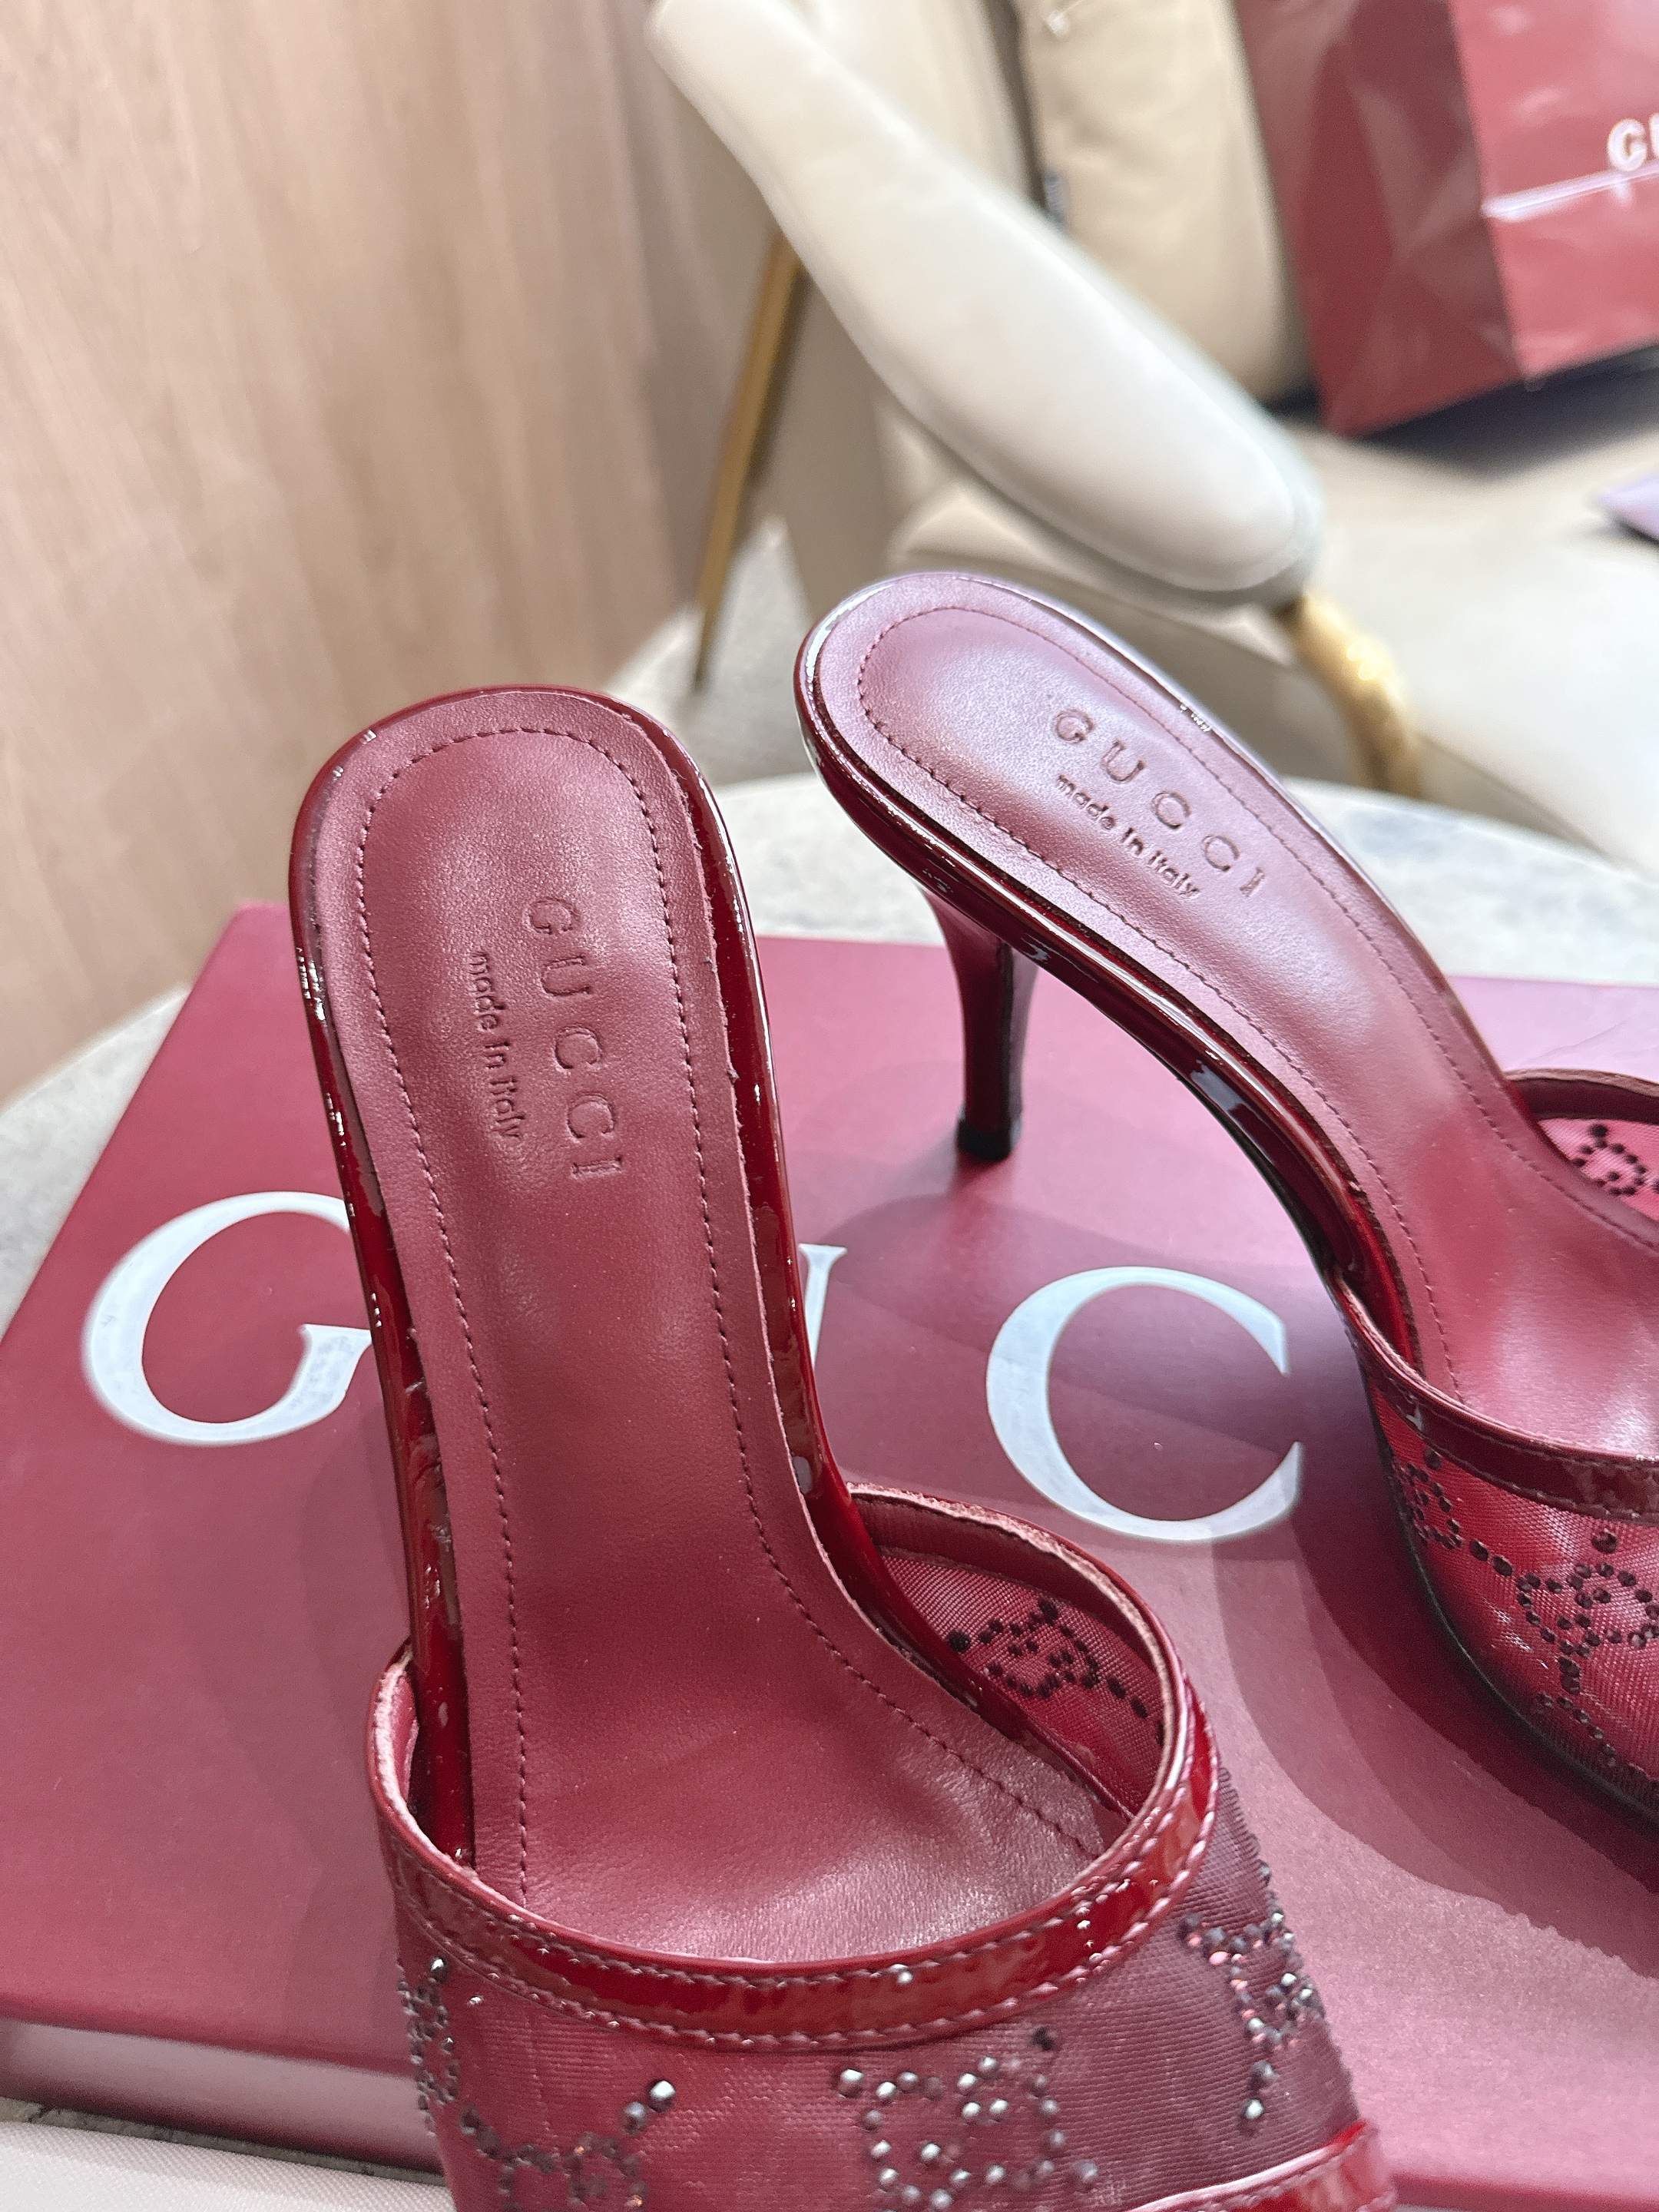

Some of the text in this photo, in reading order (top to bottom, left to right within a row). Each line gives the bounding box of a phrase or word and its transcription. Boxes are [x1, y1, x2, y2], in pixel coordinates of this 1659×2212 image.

[1055, 708, 1265, 897] GUCCI
[1056, 773, 1200, 898] made in Italy
[469, 952, 525, 1139] made in Italy
[523, 896, 623, 1178] GUCCI
